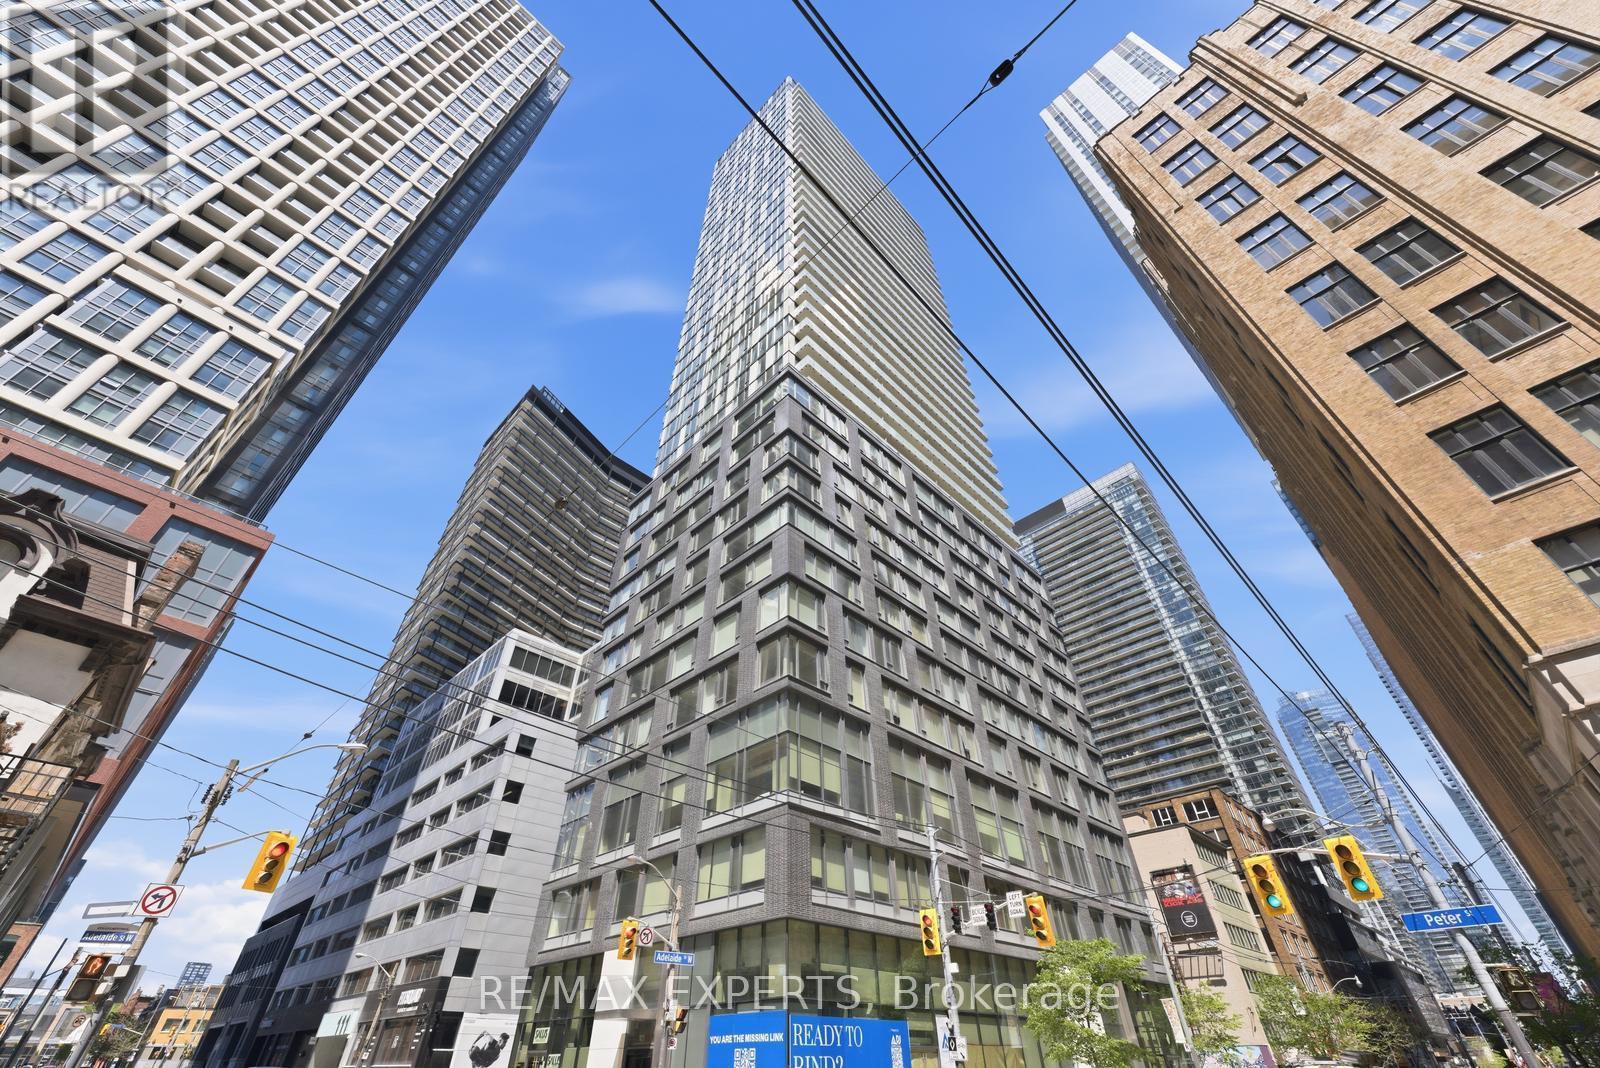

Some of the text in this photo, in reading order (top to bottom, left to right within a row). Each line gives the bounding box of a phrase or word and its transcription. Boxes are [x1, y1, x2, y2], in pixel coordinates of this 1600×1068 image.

[1010, 908, 1024, 916] SIGNAL
[1424, 909, 1473, 927] Peter St
[82, 932, 118, 942] Adelaide
[125, 934, 135, 942] W
[656, 952, 682, 963] Adelaide
[710, 1032, 784, 1044] YOU ARE THE MISSING LINK
[792, 1023, 864, 1048] READY TO
